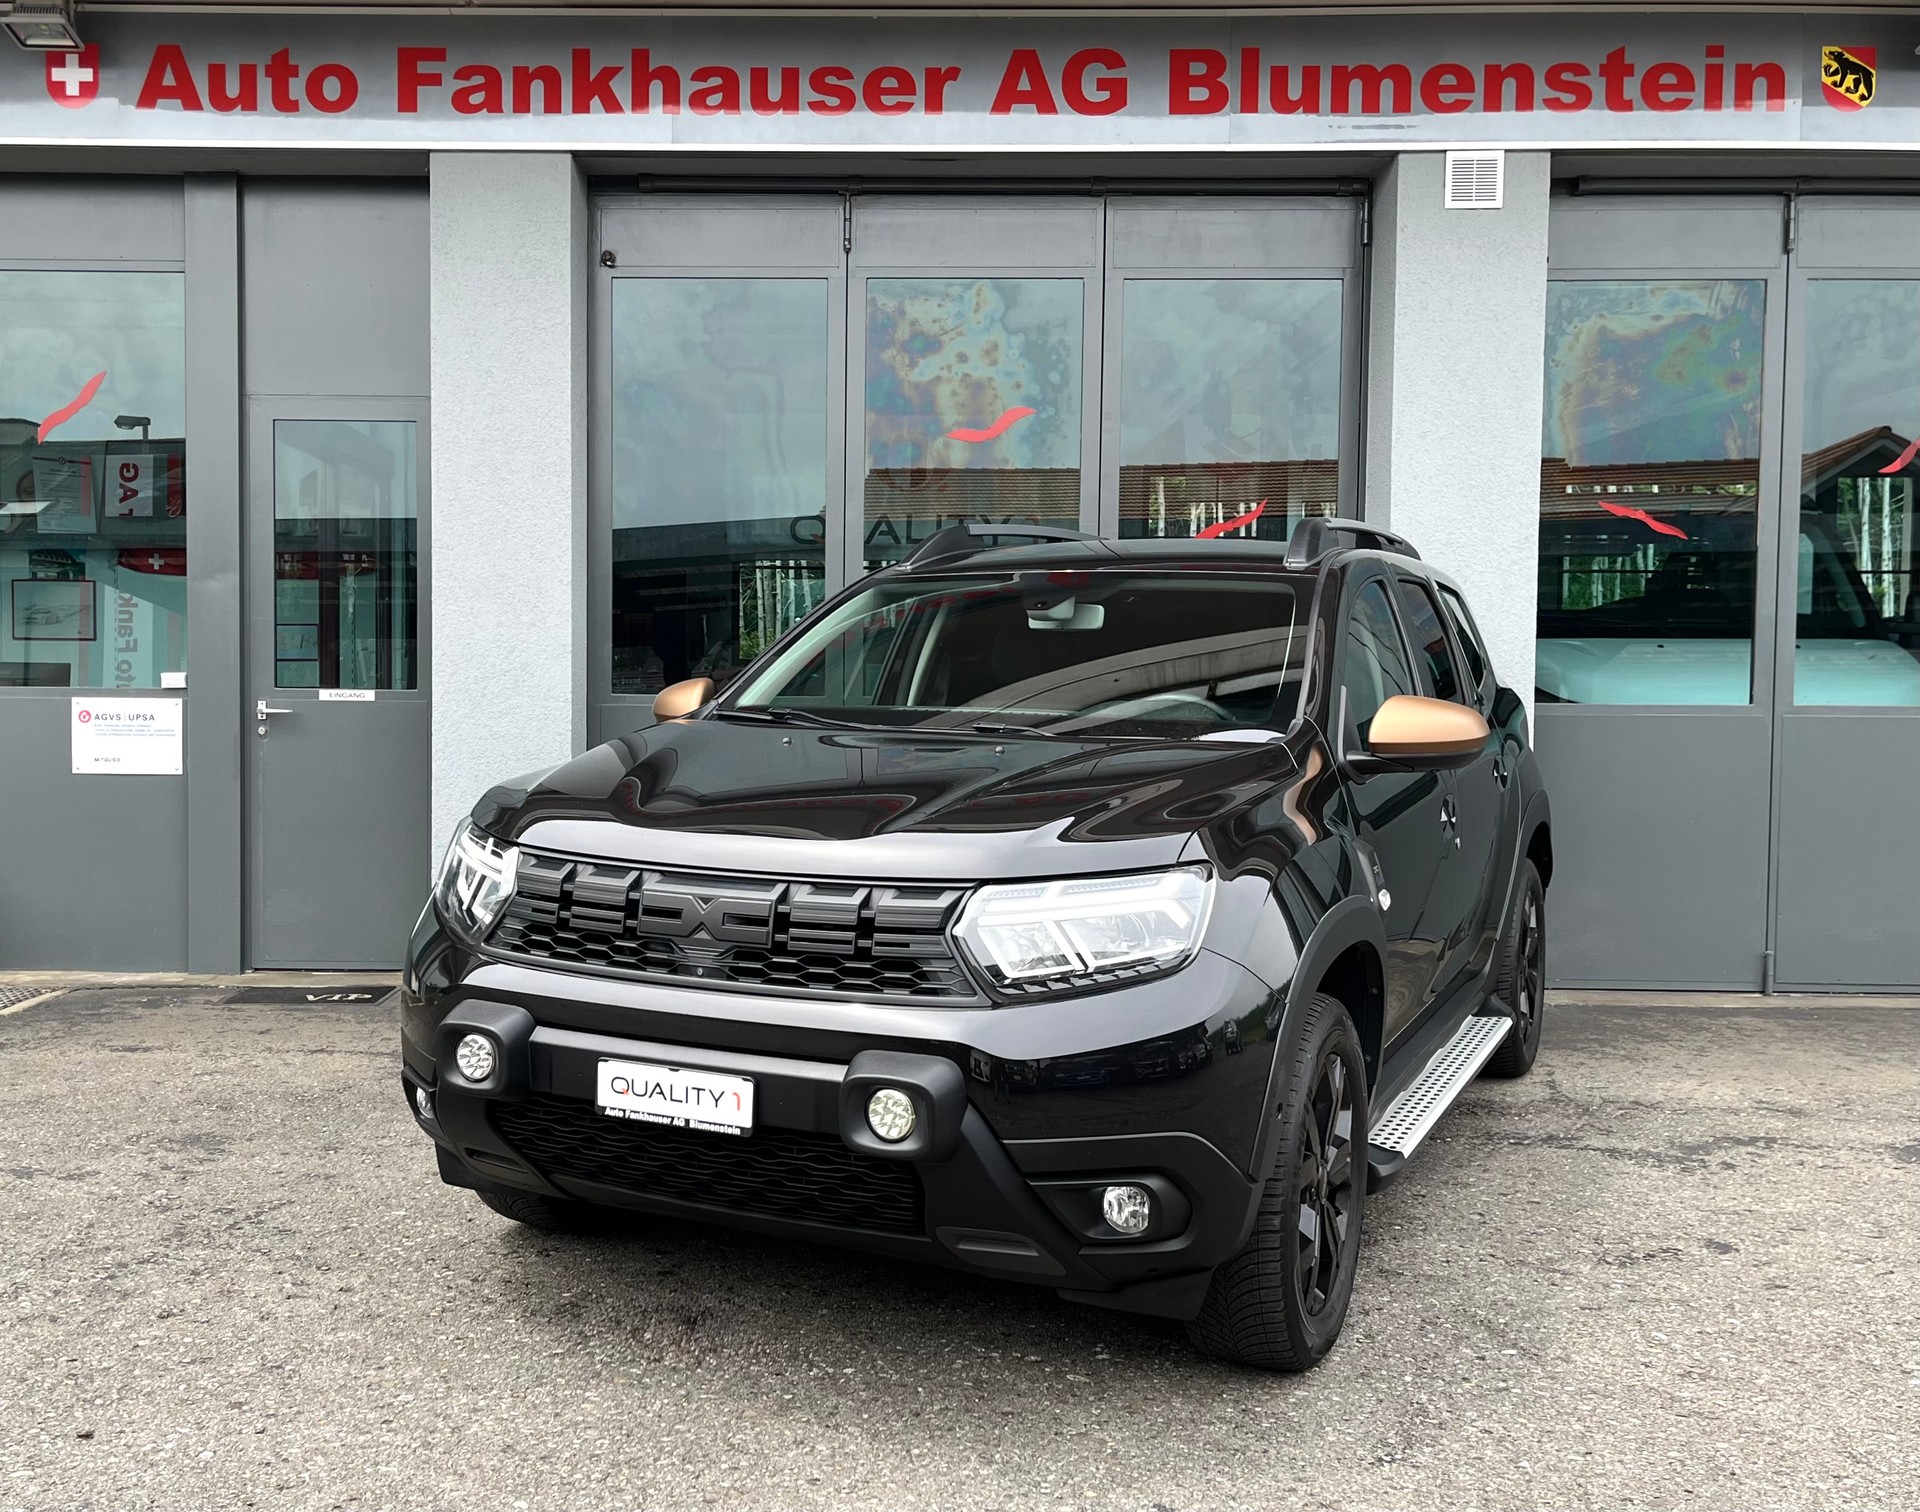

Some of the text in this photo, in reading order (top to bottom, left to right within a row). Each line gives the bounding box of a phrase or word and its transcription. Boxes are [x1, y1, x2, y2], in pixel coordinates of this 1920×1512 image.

[137, 44, 1786, 116] Auto Fankhauser AG Blumenstein
[94, 713, 155, 721] AGVS UPSA
[305, 993, 373, 1001] VIP
[605, 1107, 741, 1136] Auto Fankhauser AG Blumenstein
